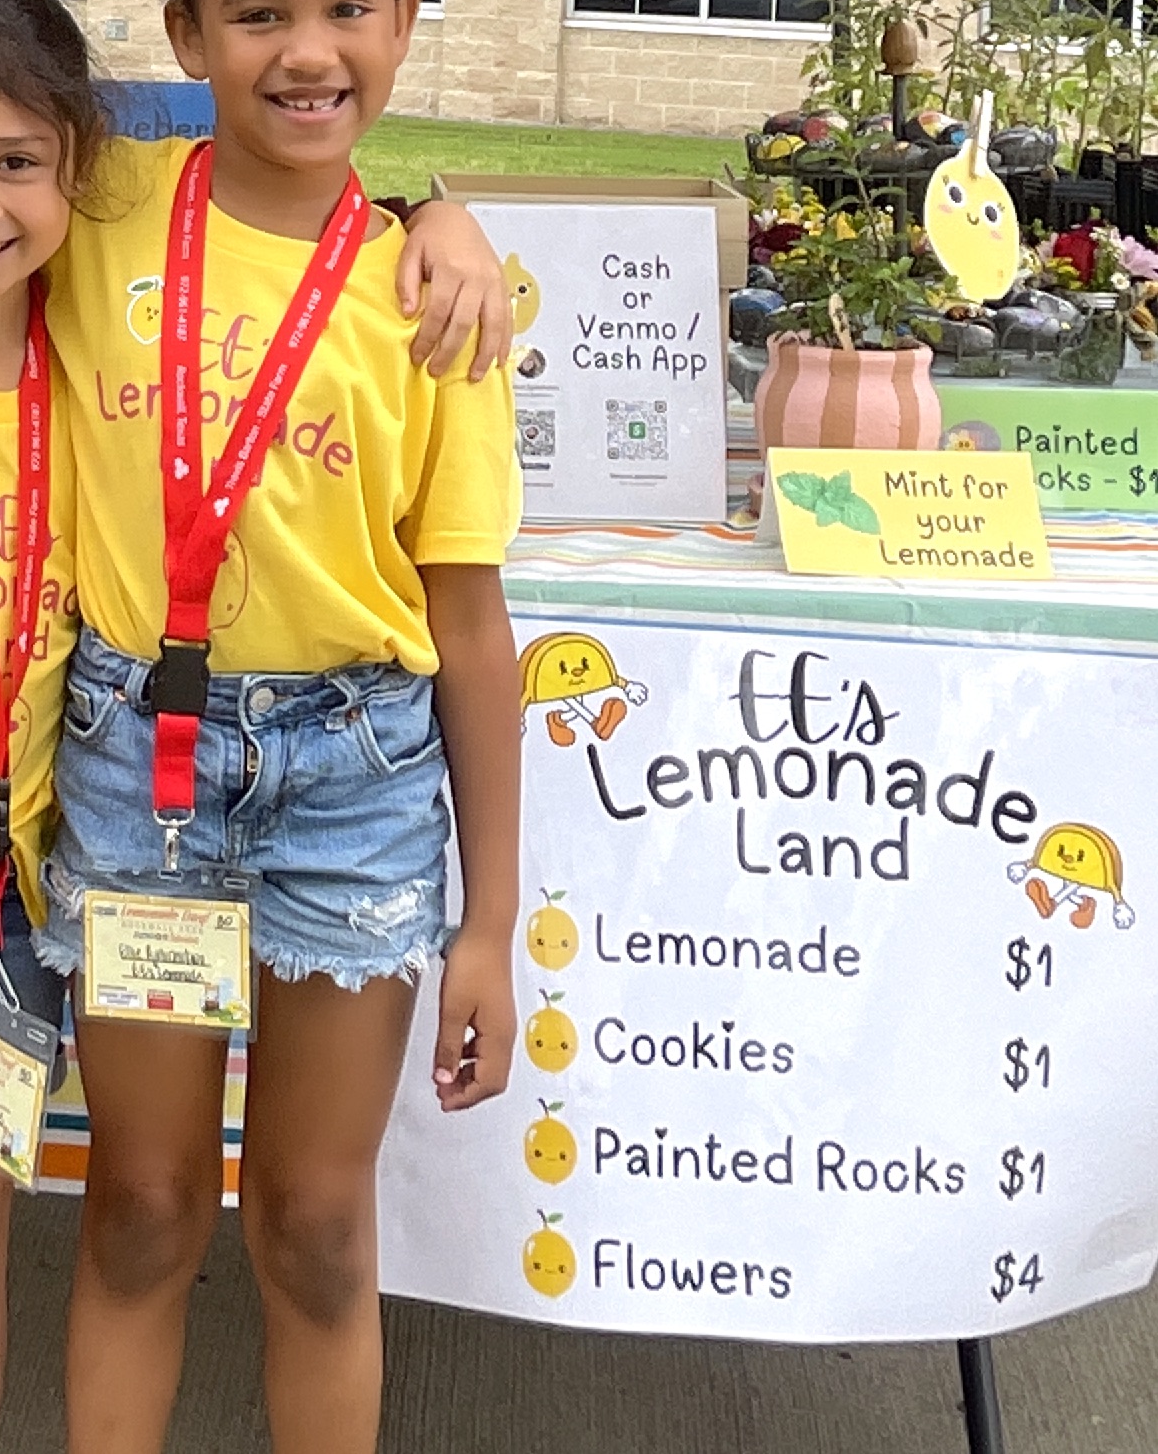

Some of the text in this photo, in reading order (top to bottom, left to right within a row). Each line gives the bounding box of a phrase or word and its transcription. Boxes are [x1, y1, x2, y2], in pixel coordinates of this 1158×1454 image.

[603, 254, 670, 279] Cash
[623, 291, 652, 309] or
[577, 312, 700, 341] Venmo /
[573, 344, 707, 380] Cash App
[1016, 424, 1139, 456] Painted
[884, 470, 1009, 500] Mint for
[917, 513, 986, 539] your
[879, 539, 1034, 567] Lemonade
[729, 650, 900, 744] EE's
[588, 744, 1038, 843] Lemonade
[737, 808, 909, 881] Land
[596, 914, 1054, 992] Lemonade $1
[594, 1018, 1052, 1091] Cookies $1
[594, 1127, 1046, 1200] Painted Rocks $1
[593, 1239, 1045, 1303] Flowers $4
